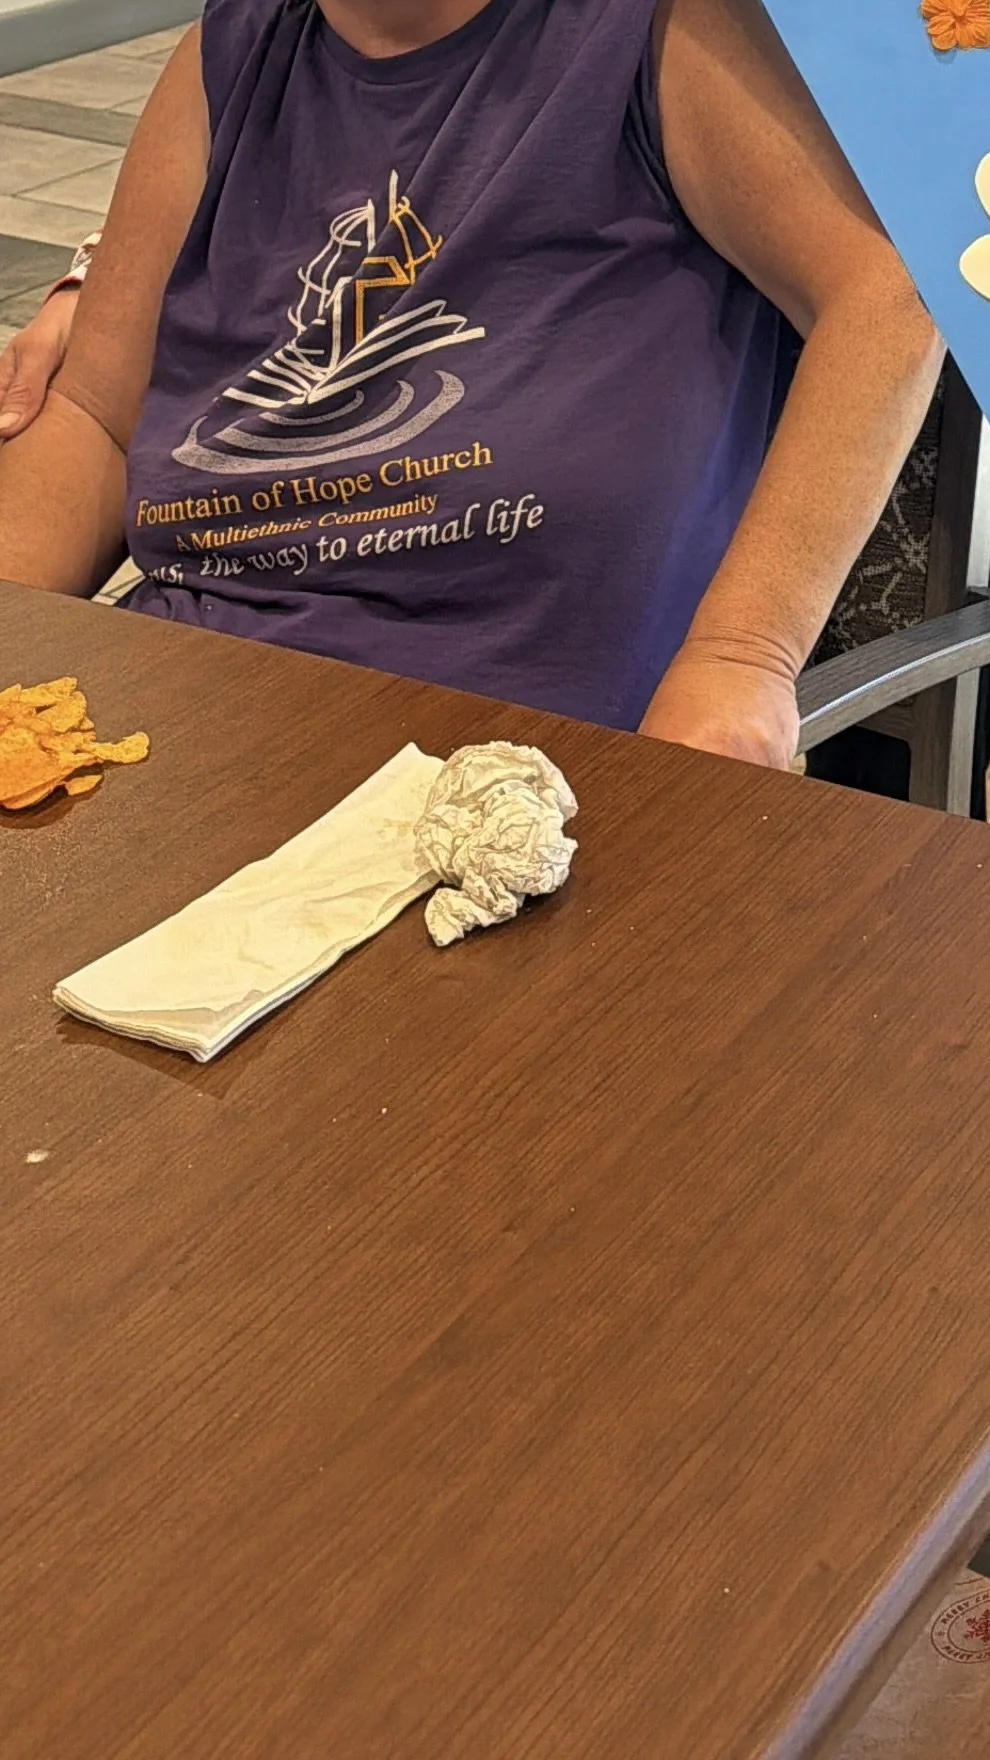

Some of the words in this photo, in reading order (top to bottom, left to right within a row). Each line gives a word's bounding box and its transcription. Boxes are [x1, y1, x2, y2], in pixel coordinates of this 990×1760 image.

[136, 488, 244, 527] Fountain
[251, 480, 286, 511] of
[289, 473, 373, 505] Hope
[379, 441, 493, 487] Church
[176, 534, 190, 552] A
[190, 517, 312, 551] Multiethnic
[318, 493, 439, 527] Community
[200, 552, 245, 577] the
[248, 543, 308, 576] way
[316, 535, 347, 562] to
[357, 503, 481, 557] eternal
[486, 493, 544, 544] life
